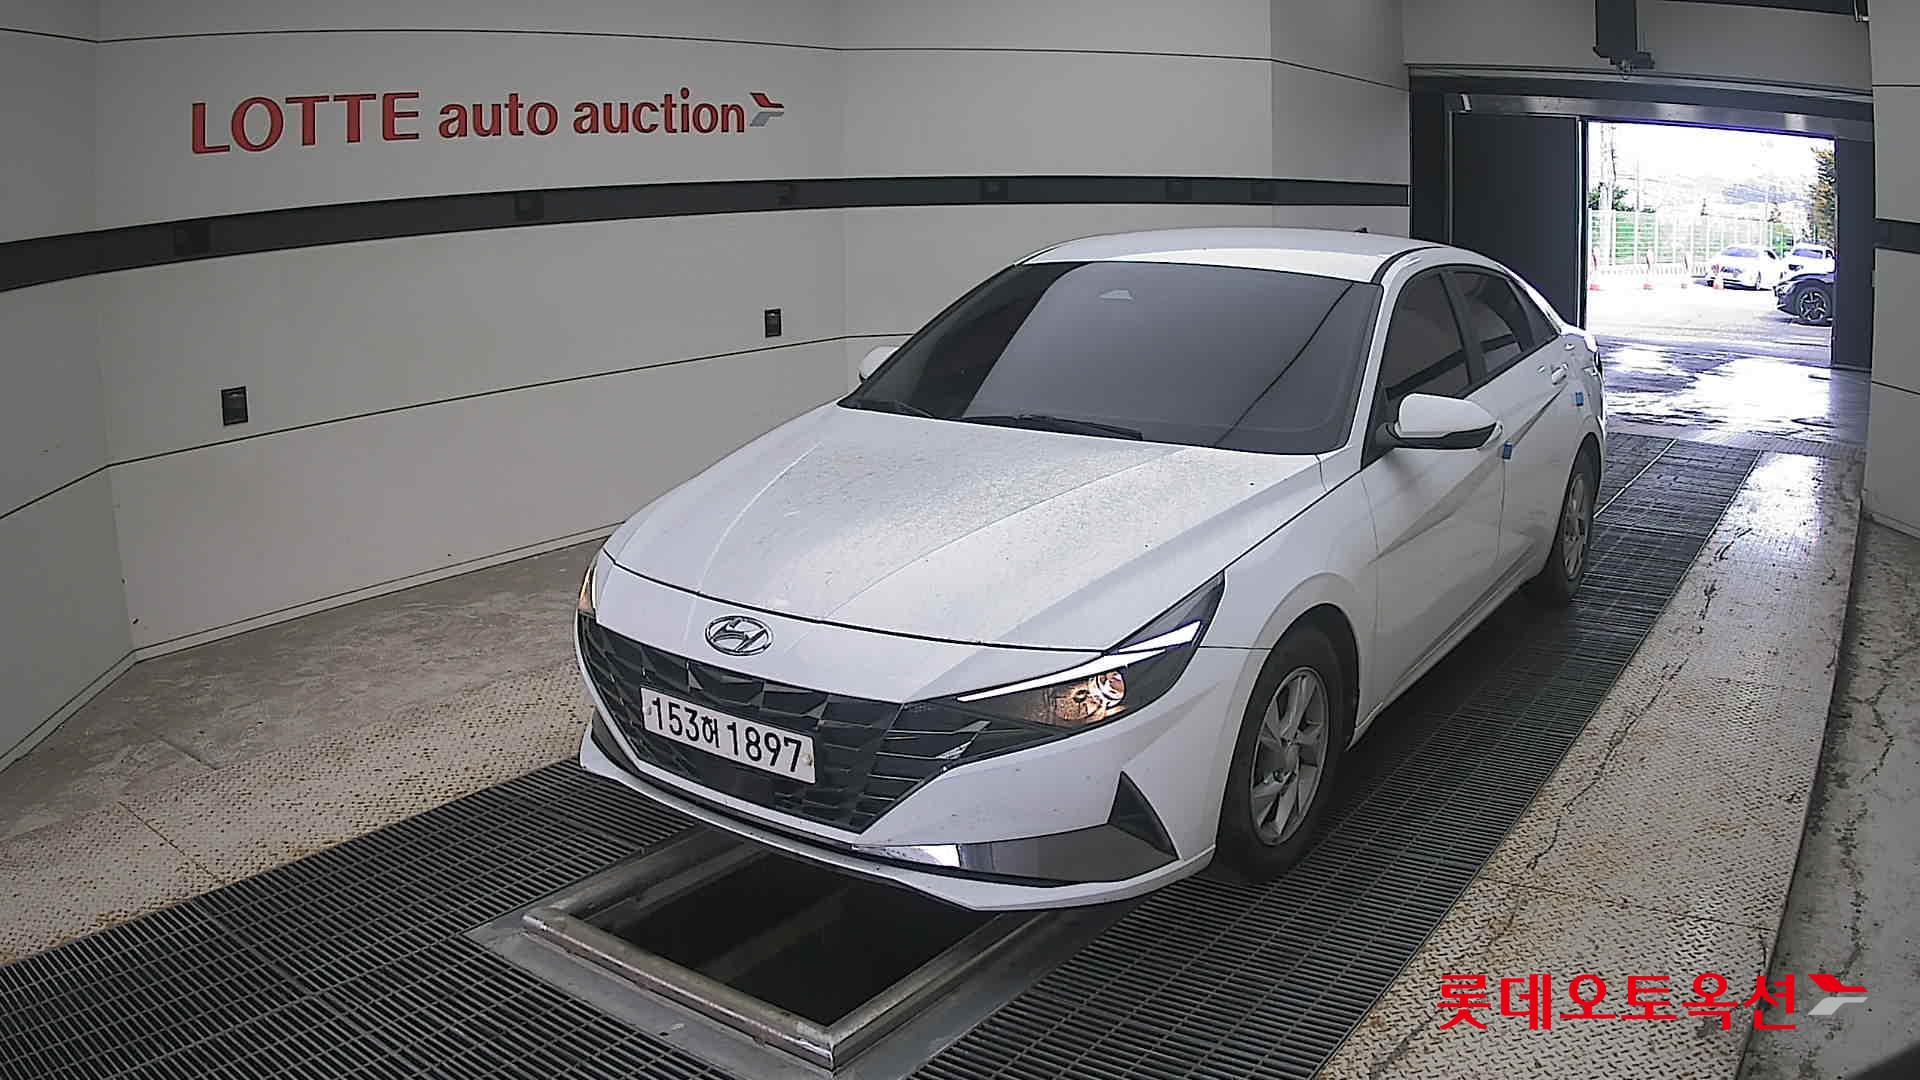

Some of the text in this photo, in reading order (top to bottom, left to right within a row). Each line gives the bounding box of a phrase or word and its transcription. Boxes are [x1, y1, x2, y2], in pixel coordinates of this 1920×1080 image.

[191, 87, 746, 155] LOTTE auto auction
[652, 697, 802, 773] 153허 1897
